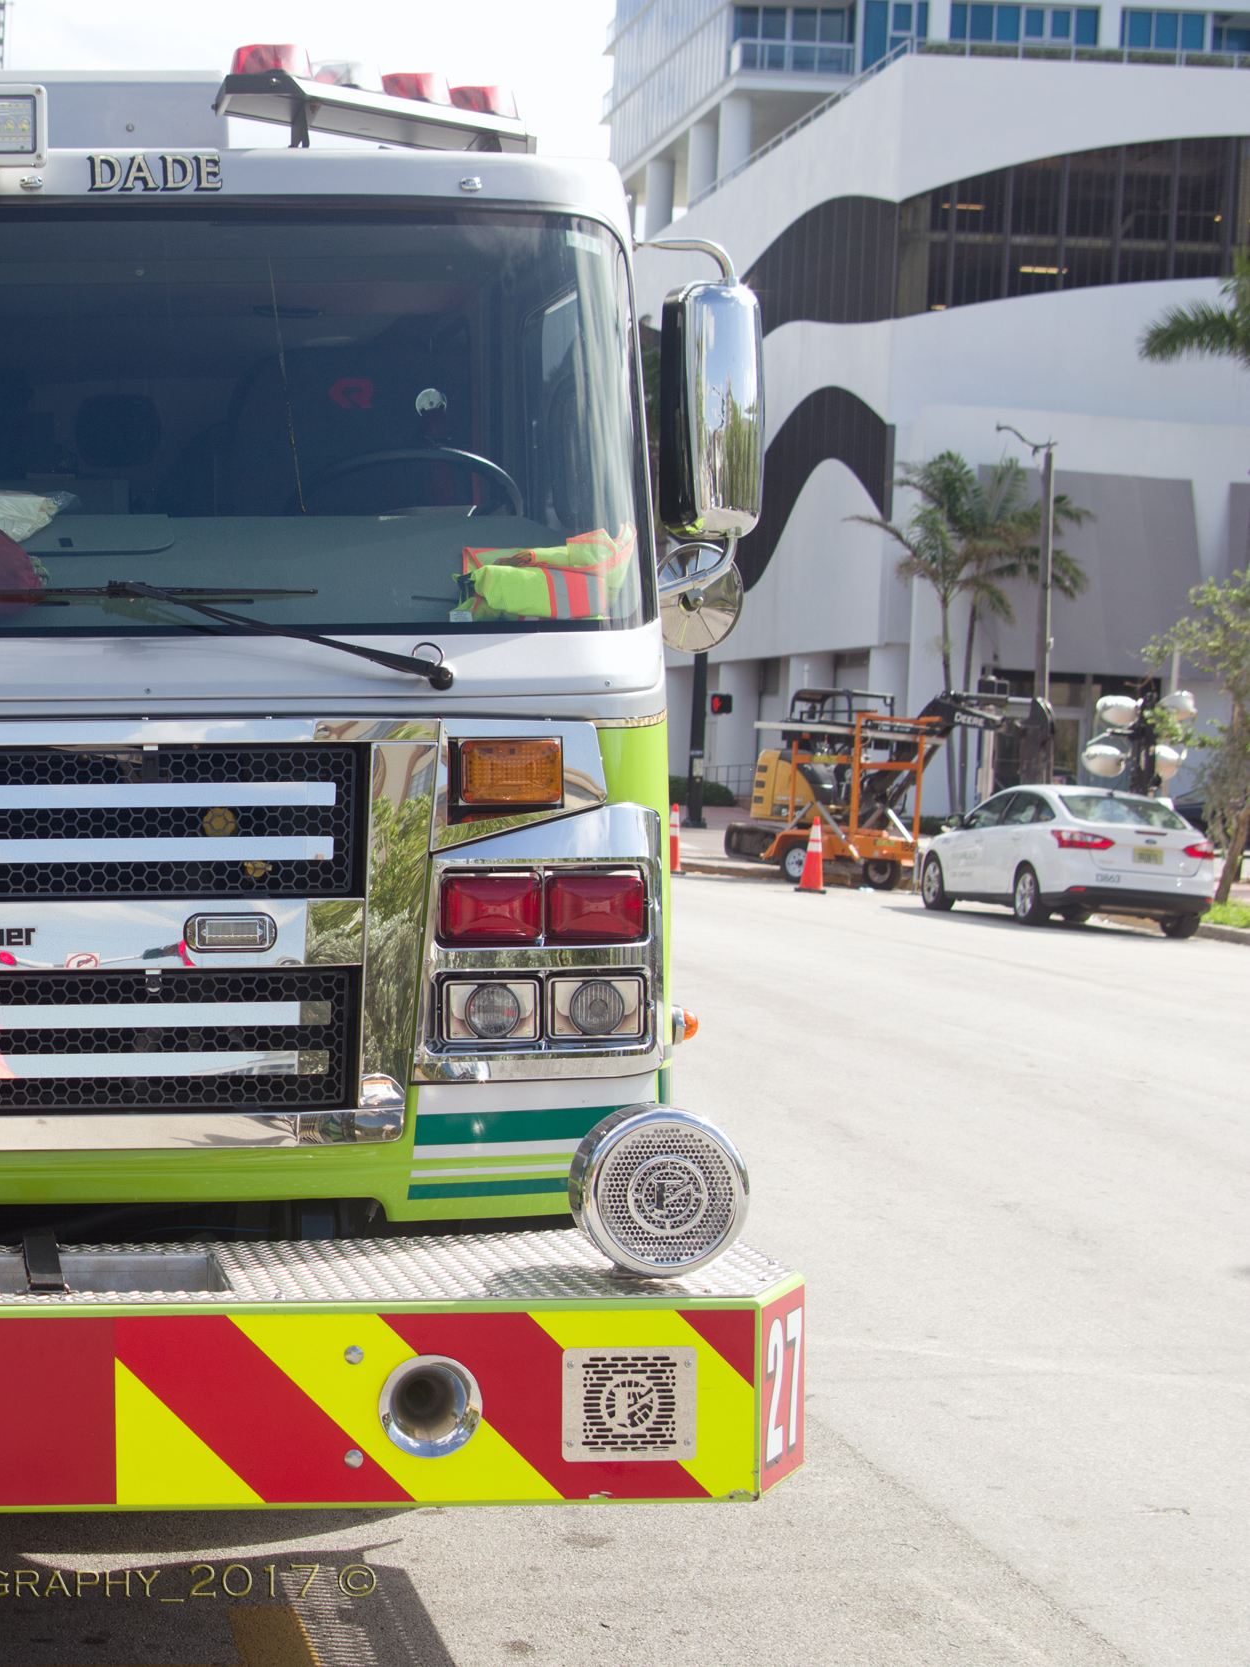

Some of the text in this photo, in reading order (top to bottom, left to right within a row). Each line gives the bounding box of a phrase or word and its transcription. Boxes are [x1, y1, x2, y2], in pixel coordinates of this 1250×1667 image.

[86, 155, 223, 192] DADE
[954, 711, 985, 728] DEERE
[764, 1305, 803, 1472] 27
